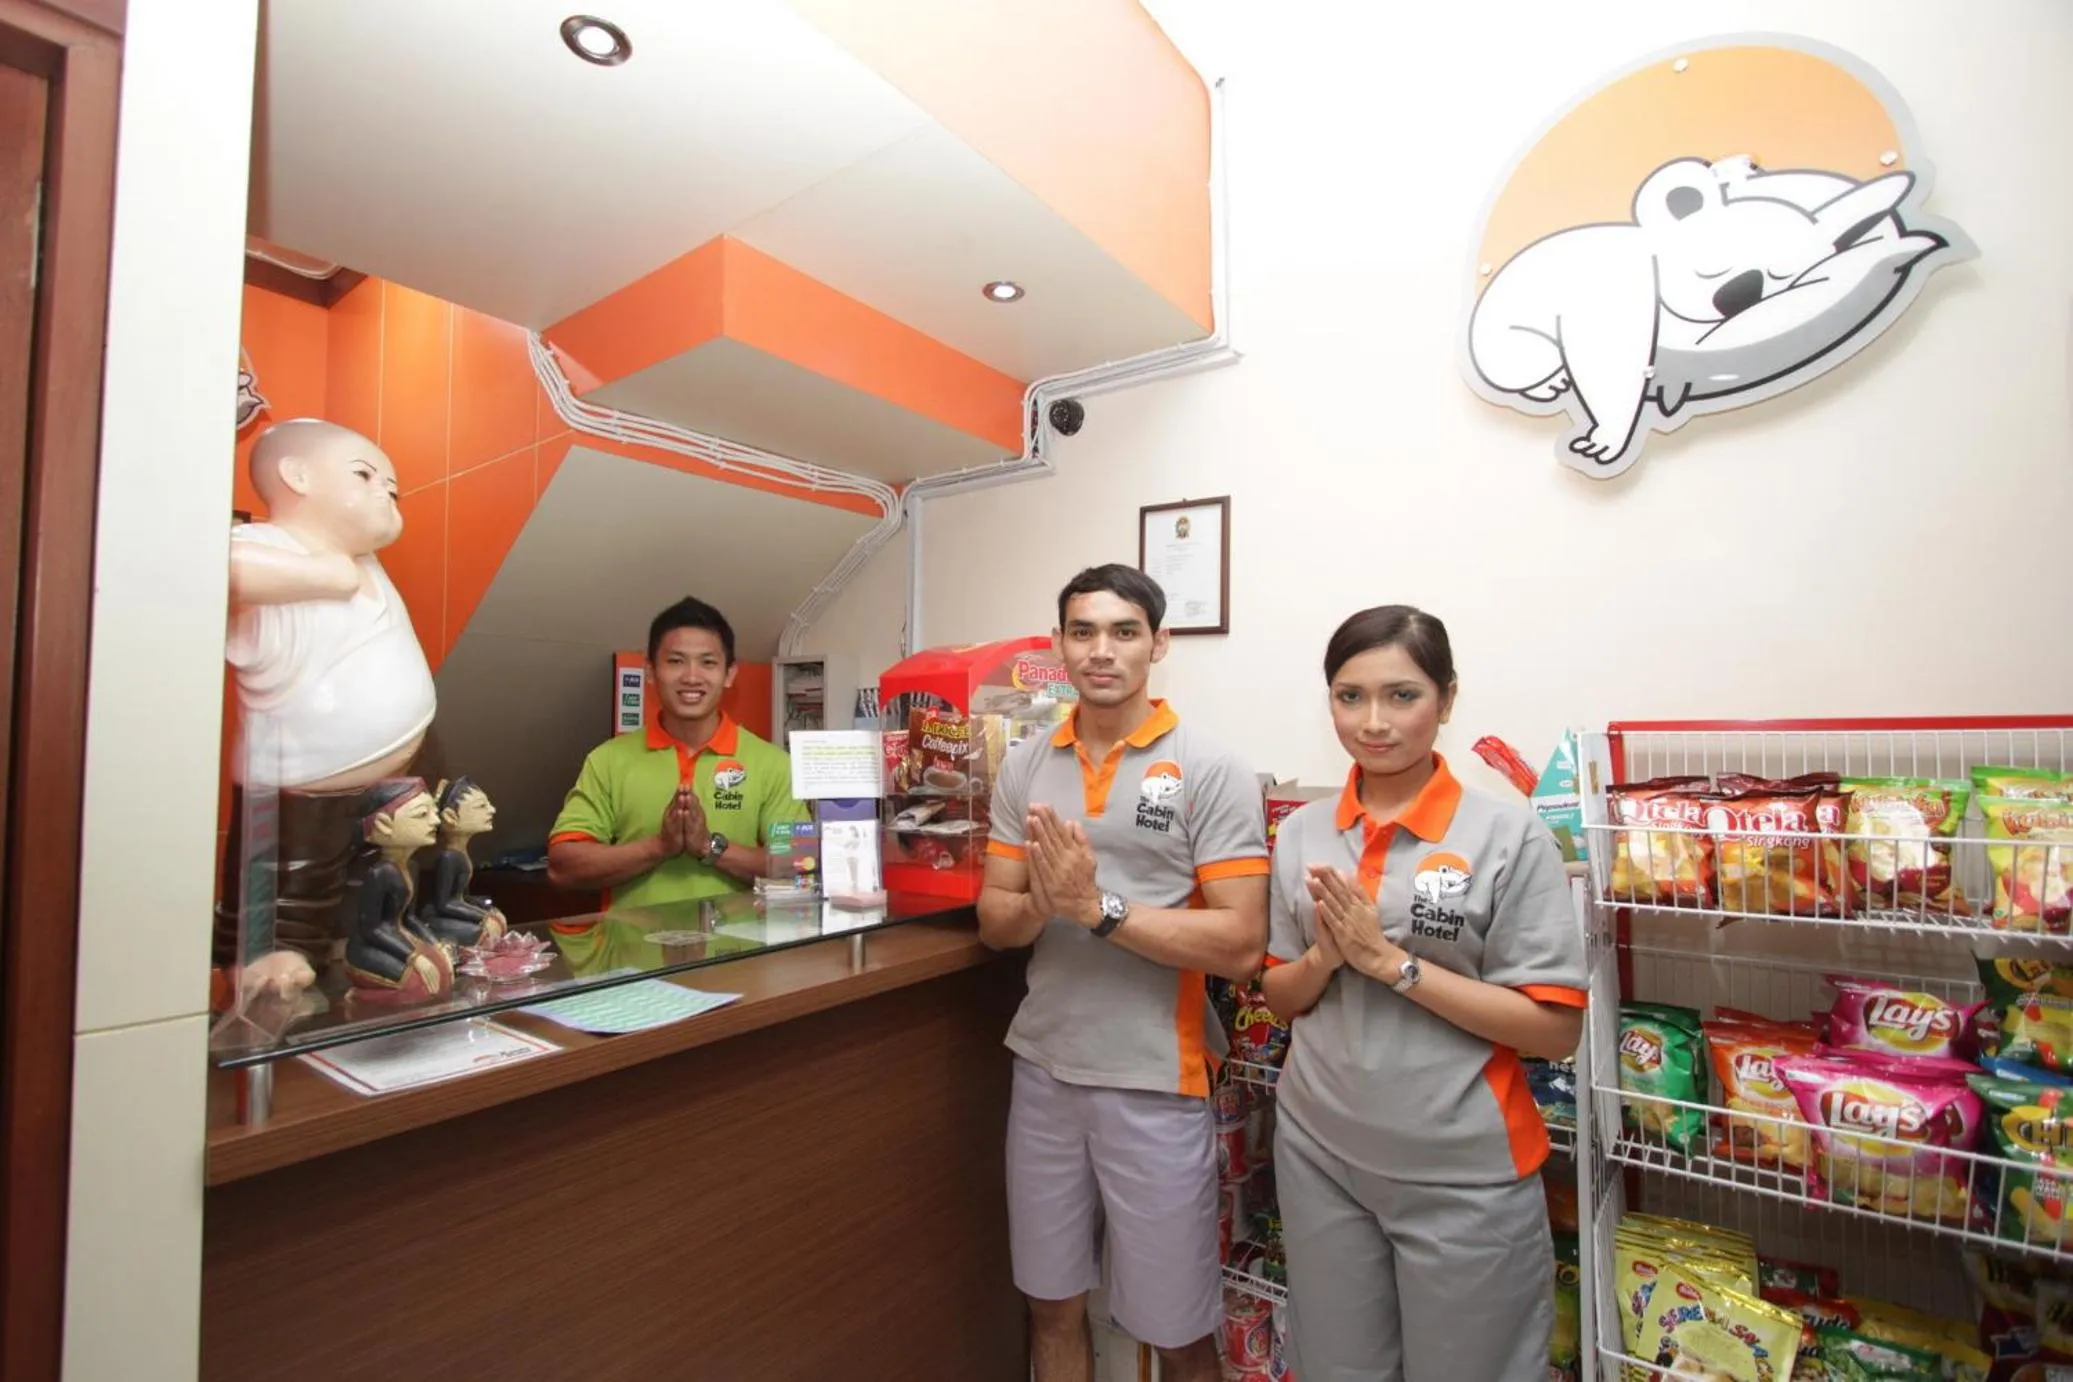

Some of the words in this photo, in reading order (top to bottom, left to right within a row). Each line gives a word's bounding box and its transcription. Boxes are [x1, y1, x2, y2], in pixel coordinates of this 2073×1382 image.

[1017, 659, 1068, 681] Panad
[1137, 802, 1175, 820] Cabin
[1705, 804, 1807, 840] Qtela
[1136, 814, 1170, 832] Hotel
[1410, 903, 1465, 927] Cabin
[1411, 918, 1460, 942] Hotel
